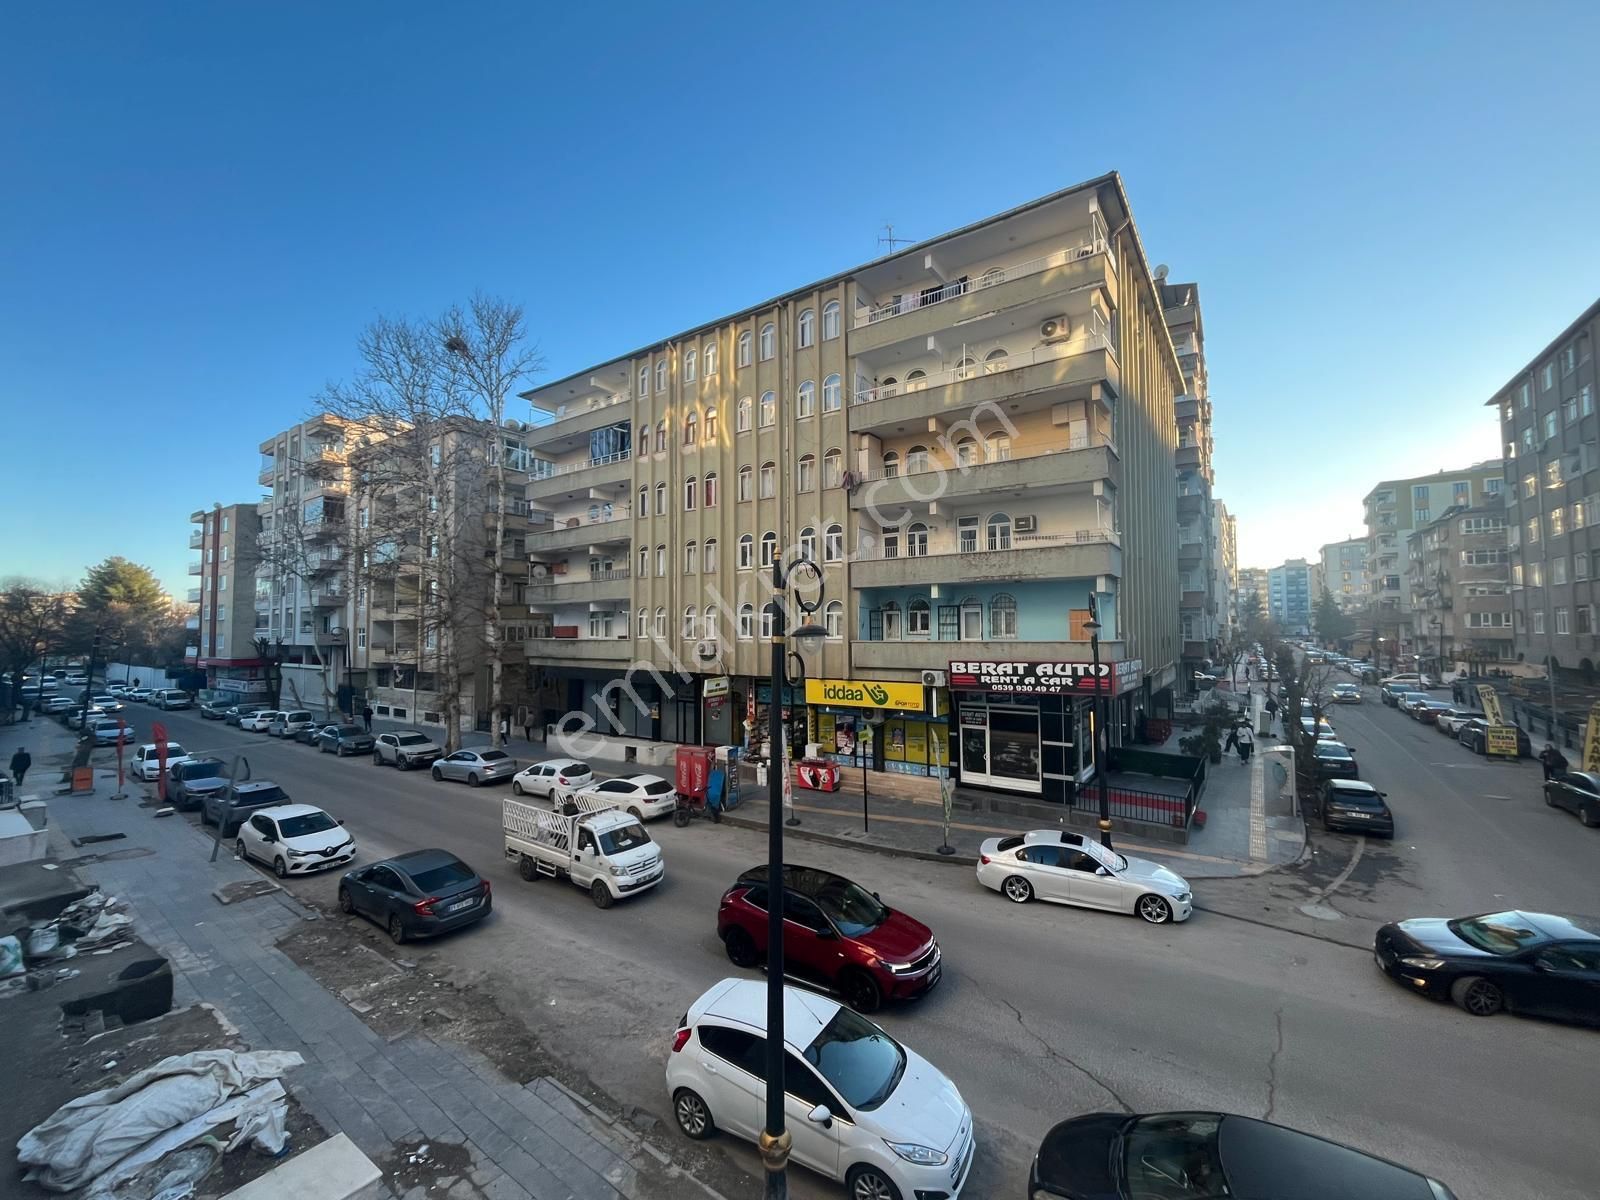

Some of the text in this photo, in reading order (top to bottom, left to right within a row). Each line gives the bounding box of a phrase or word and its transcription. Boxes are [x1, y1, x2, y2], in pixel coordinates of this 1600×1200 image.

[951, 662, 1029, 676] BERAT
[1036, 663, 1110, 677] AUTO
[980, 675, 1074, 686] RENT A CAR
[823, 683, 864, 702] iddaa
[992, 684, 1013, 692] 0539
[1035, 685, 1046, 693] 49
